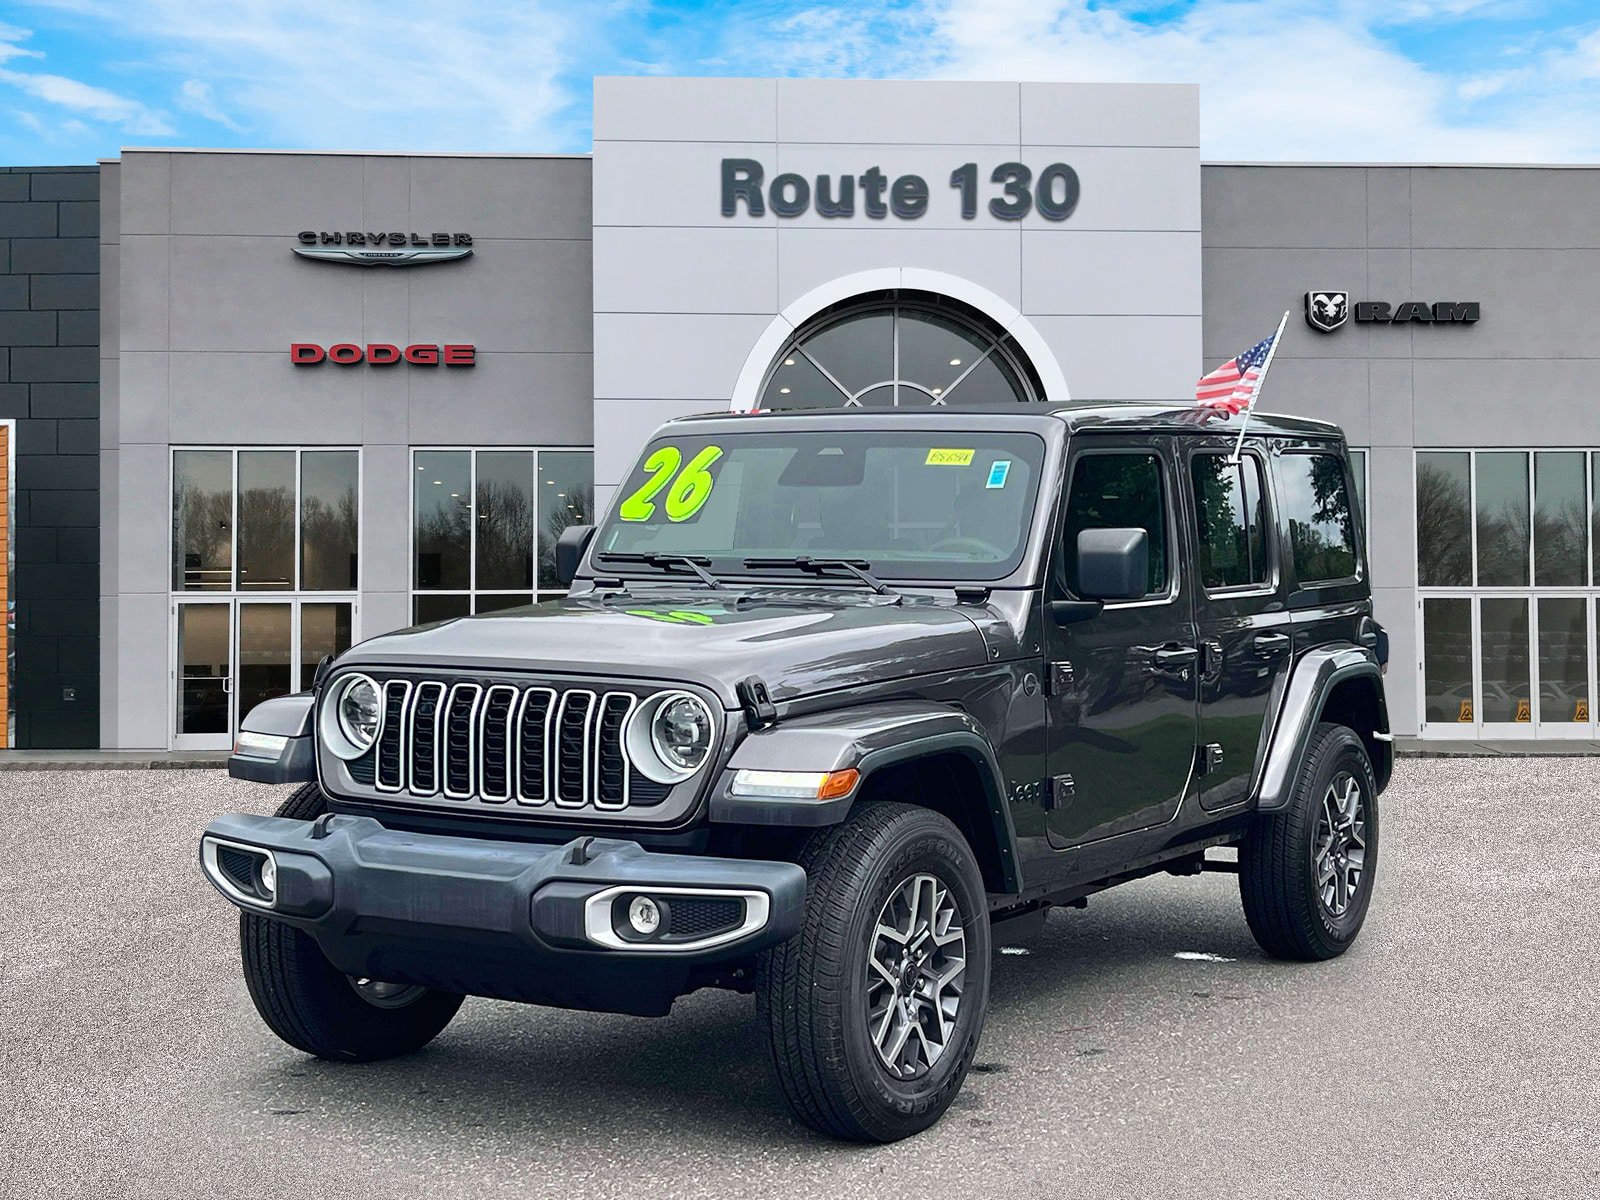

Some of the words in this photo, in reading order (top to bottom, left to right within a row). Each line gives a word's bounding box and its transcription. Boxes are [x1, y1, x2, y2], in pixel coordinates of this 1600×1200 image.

[720, 158, 929, 219] Route
[949, 162, 1081, 221] 130
[298, 231, 473, 245] CHRYSLER
[1355, 302, 1480, 323] RAM
[291, 343, 475, 366] DODGE
[620, 445, 724, 522] 26
